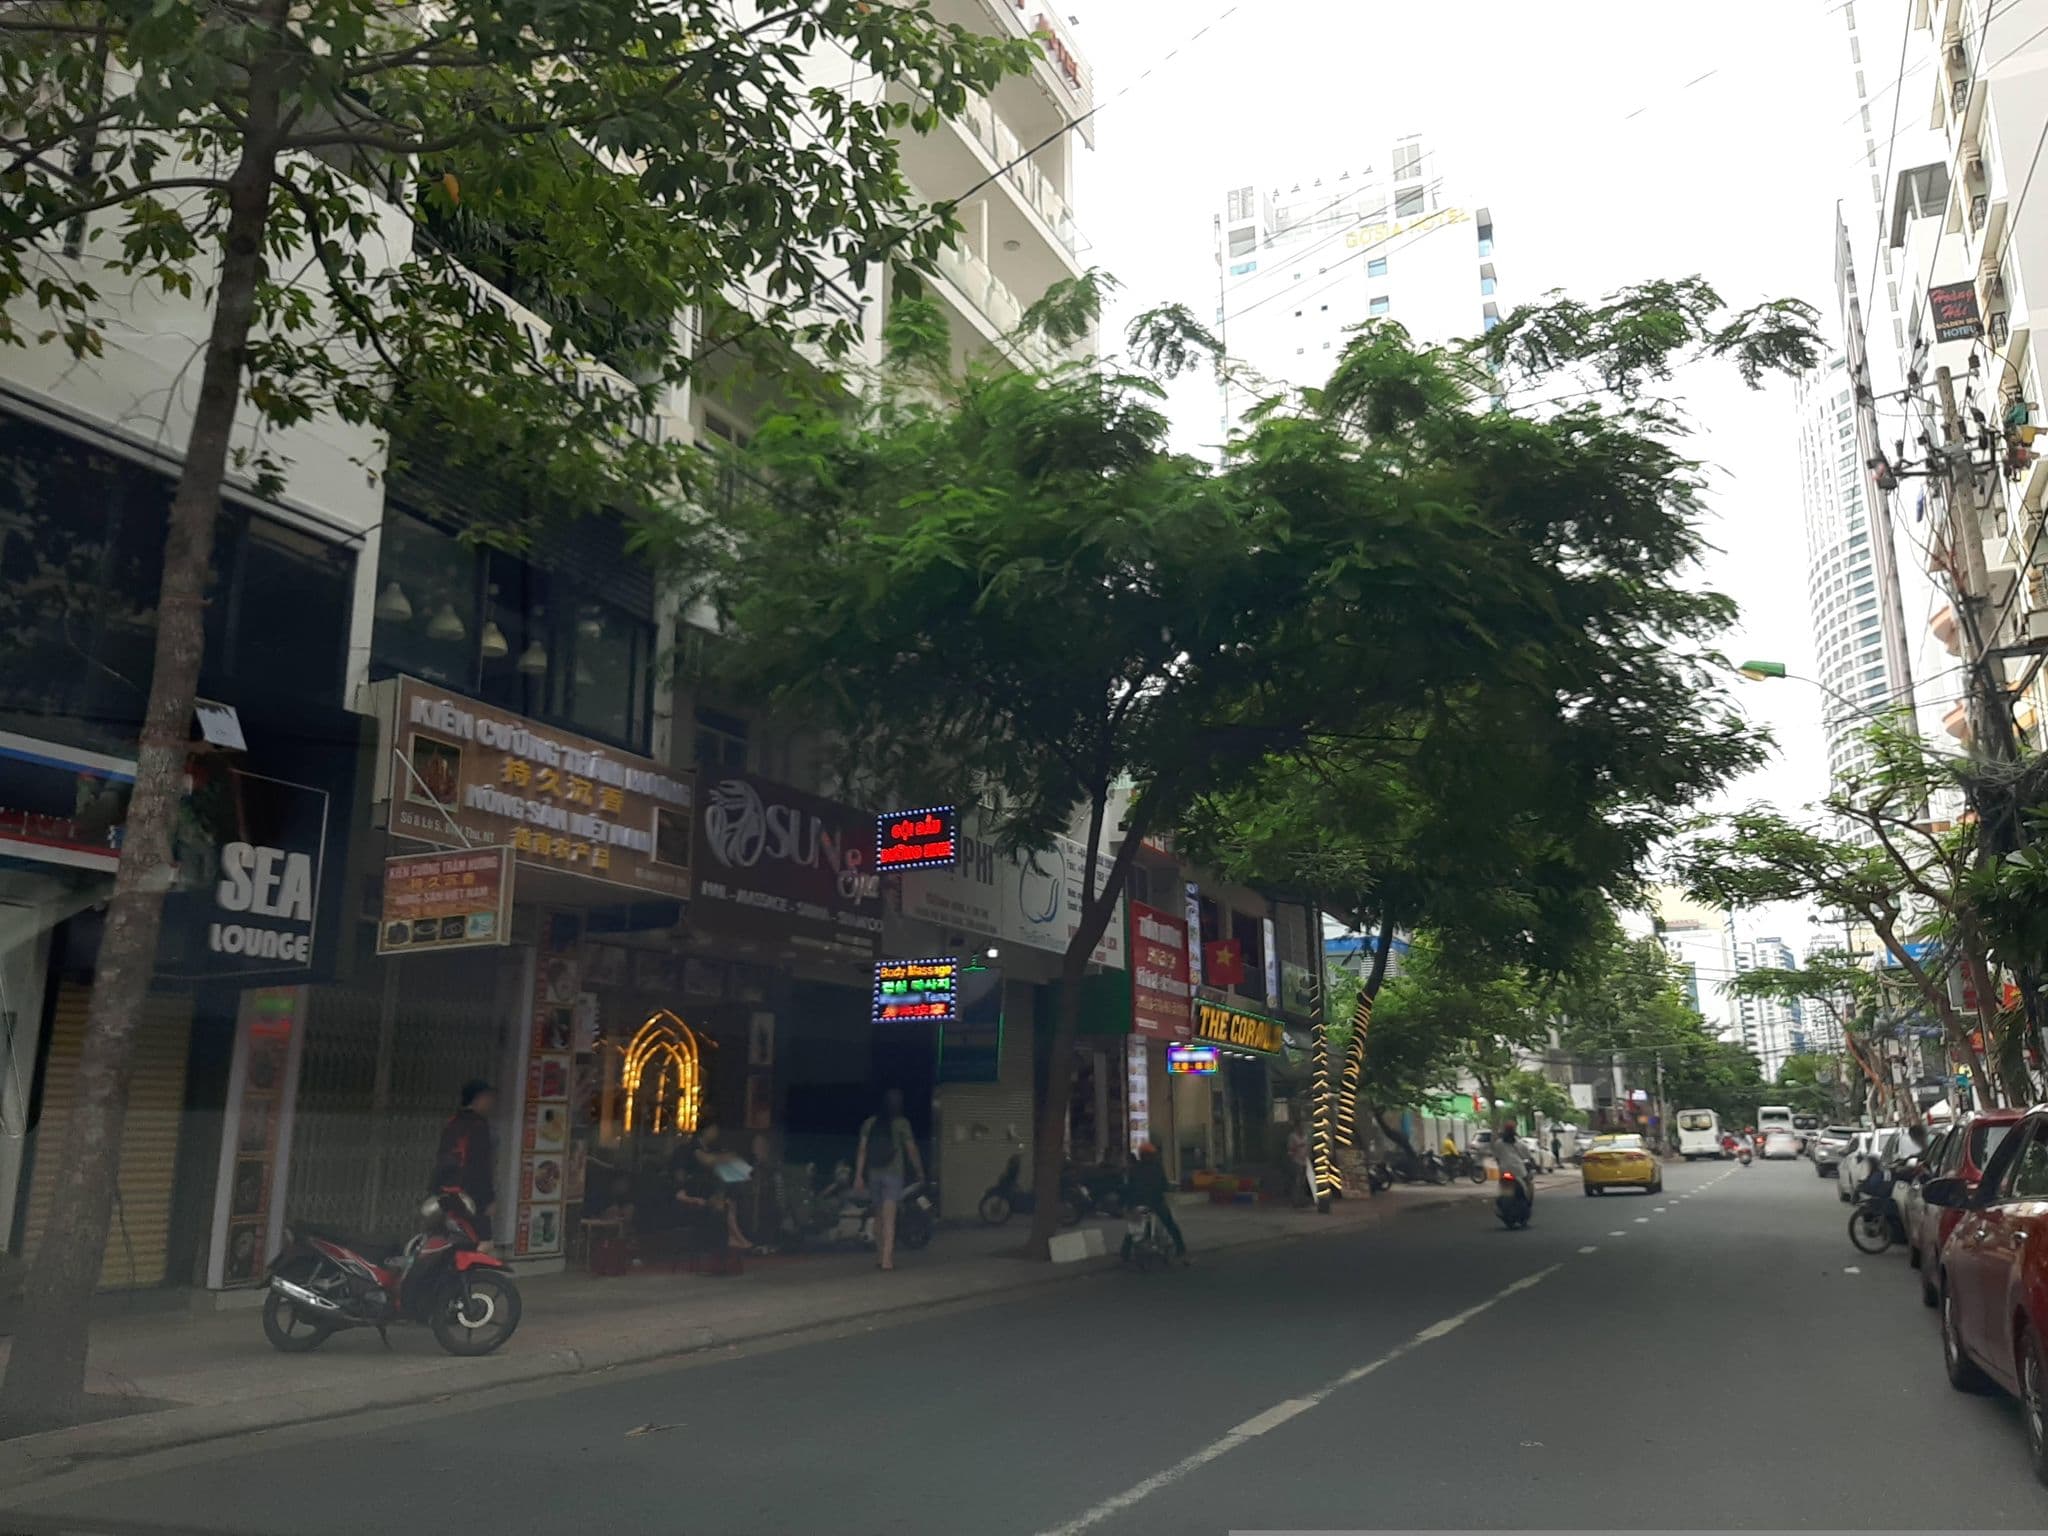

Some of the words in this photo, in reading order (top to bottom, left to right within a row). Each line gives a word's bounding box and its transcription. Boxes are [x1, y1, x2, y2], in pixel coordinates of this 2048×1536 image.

[1408, 207, 1470, 234] HOTEL
[216, 841, 312, 921] SEA
[880, 966, 906, 979] Body
[907, 965, 953, 977] Massage
[1200, 1006, 1230, 1041] THE
